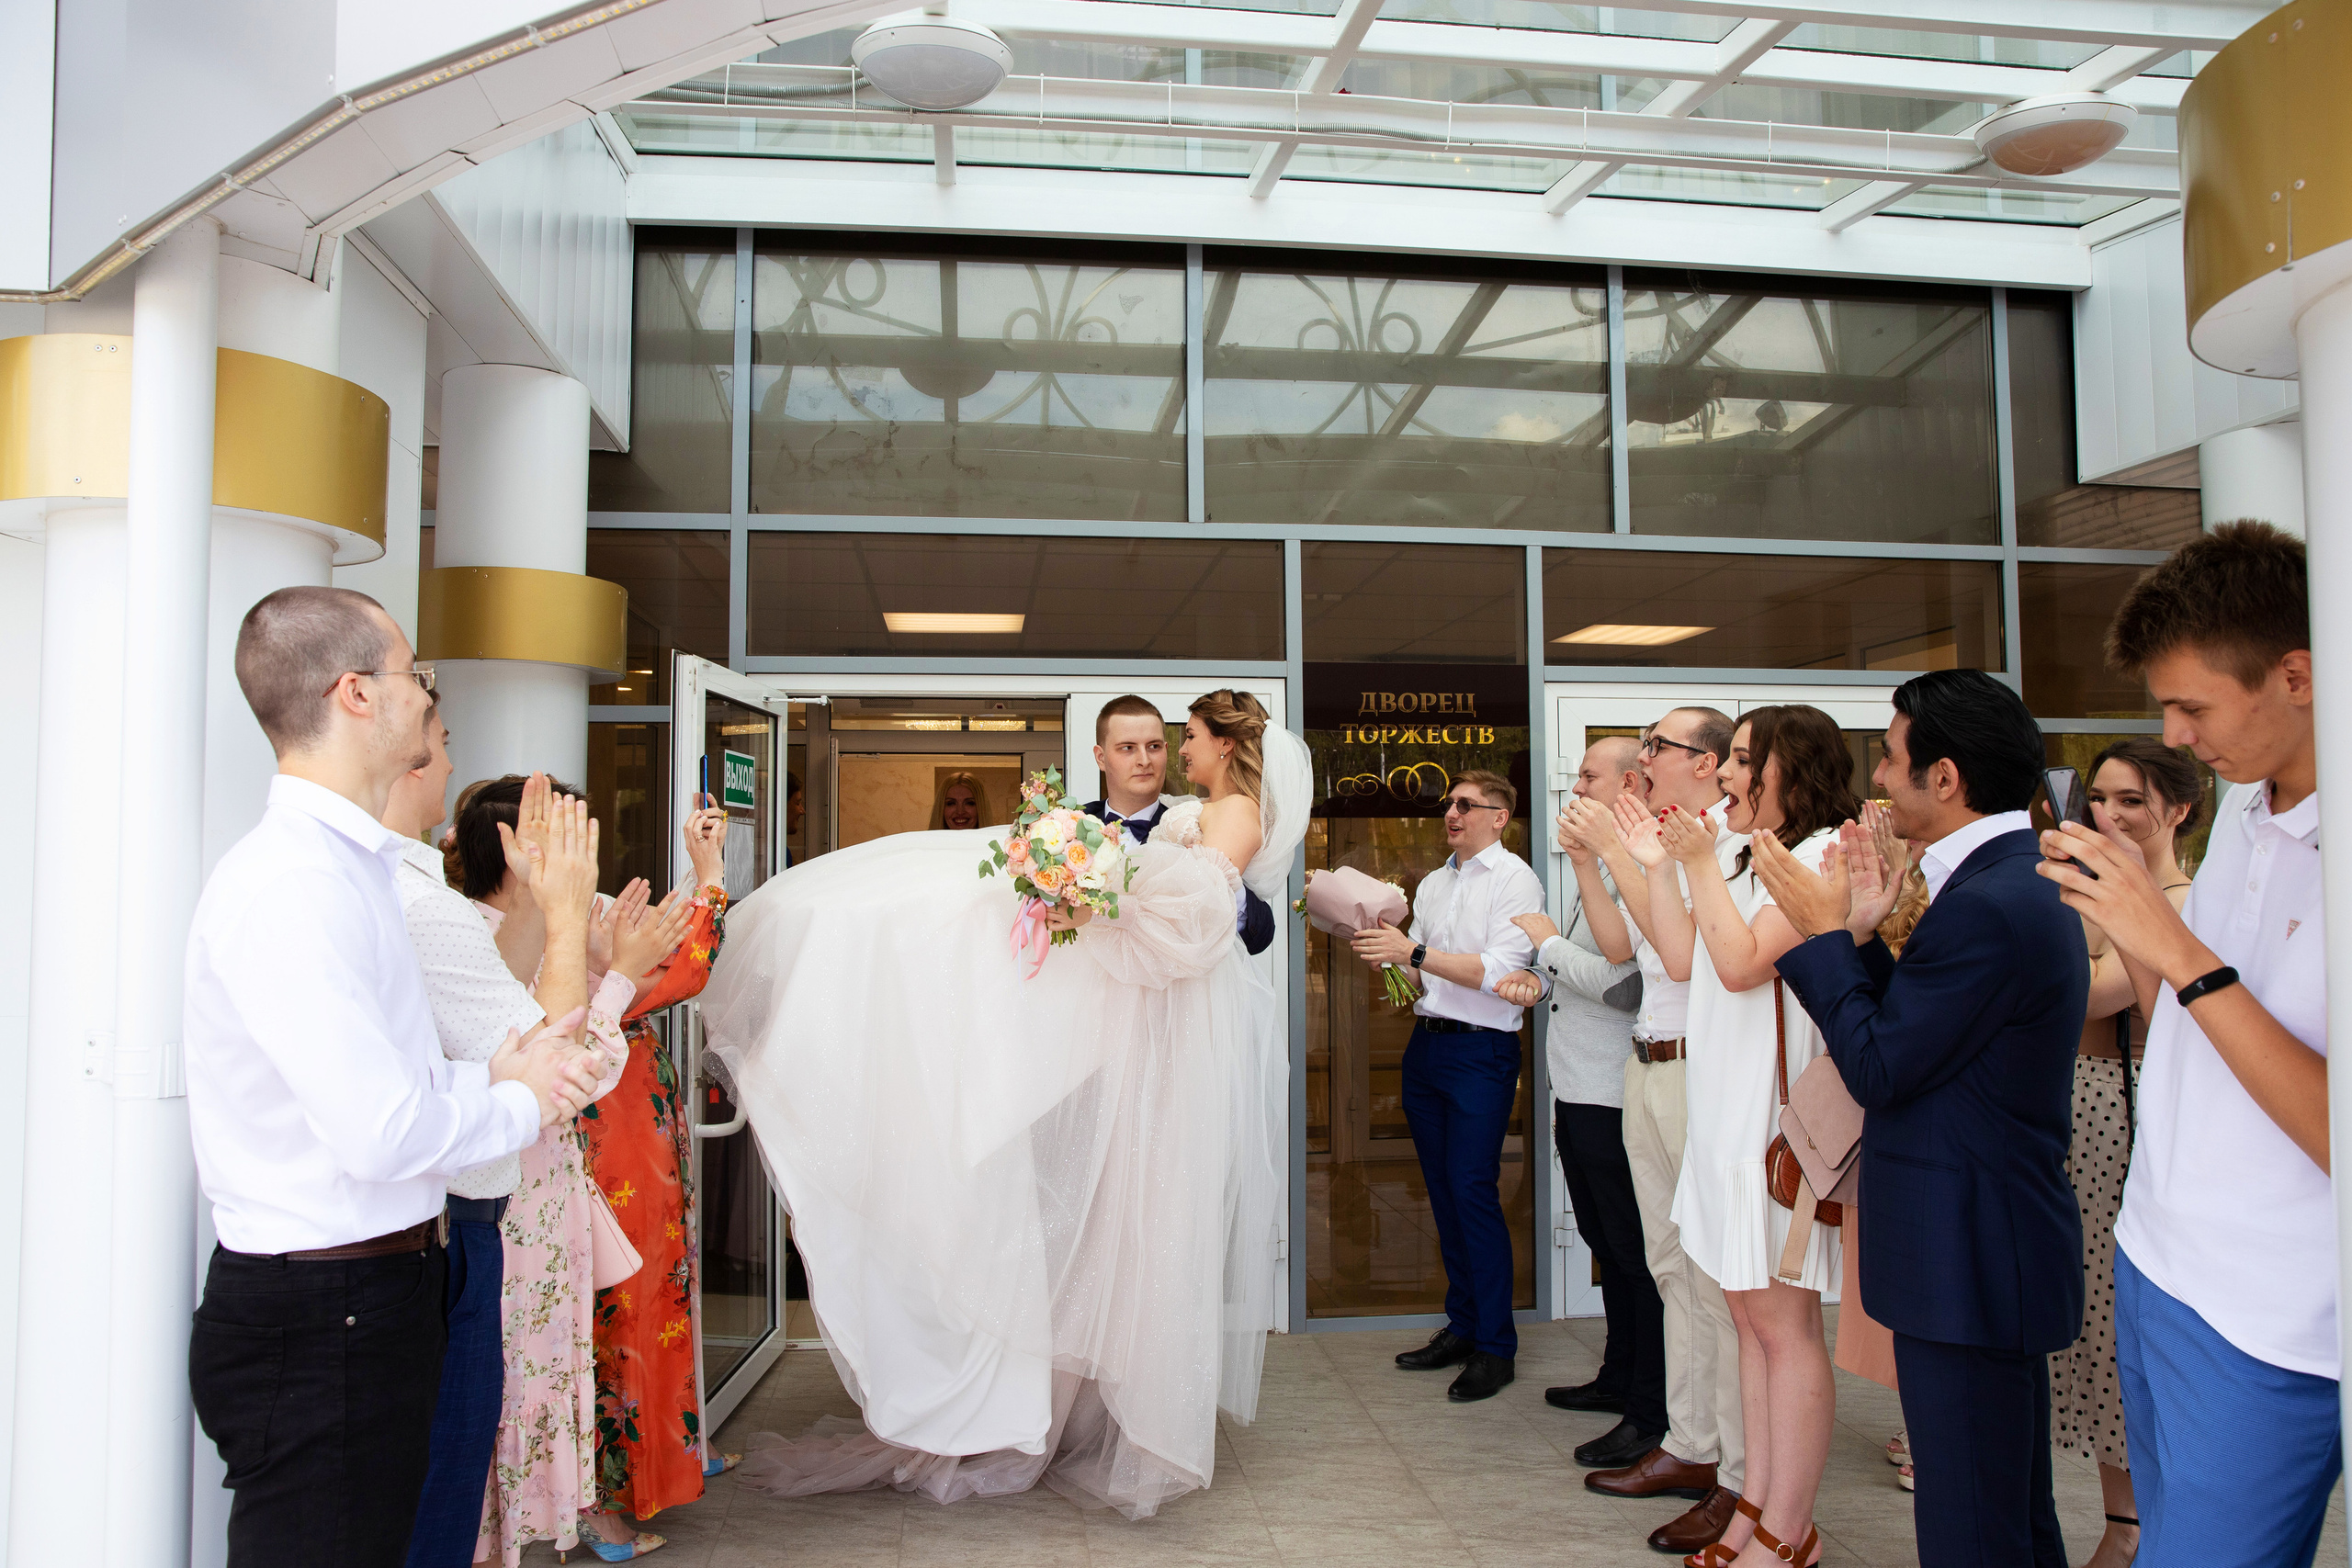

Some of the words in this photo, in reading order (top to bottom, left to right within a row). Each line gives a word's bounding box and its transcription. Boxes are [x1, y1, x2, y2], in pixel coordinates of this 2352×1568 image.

[1358, 692, 1476, 717] ДВОРЕЦ
[1340, 723, 1495, 744] ТОРЖЕСТВ
[726, 761, 754, 798] ВЫХОД
